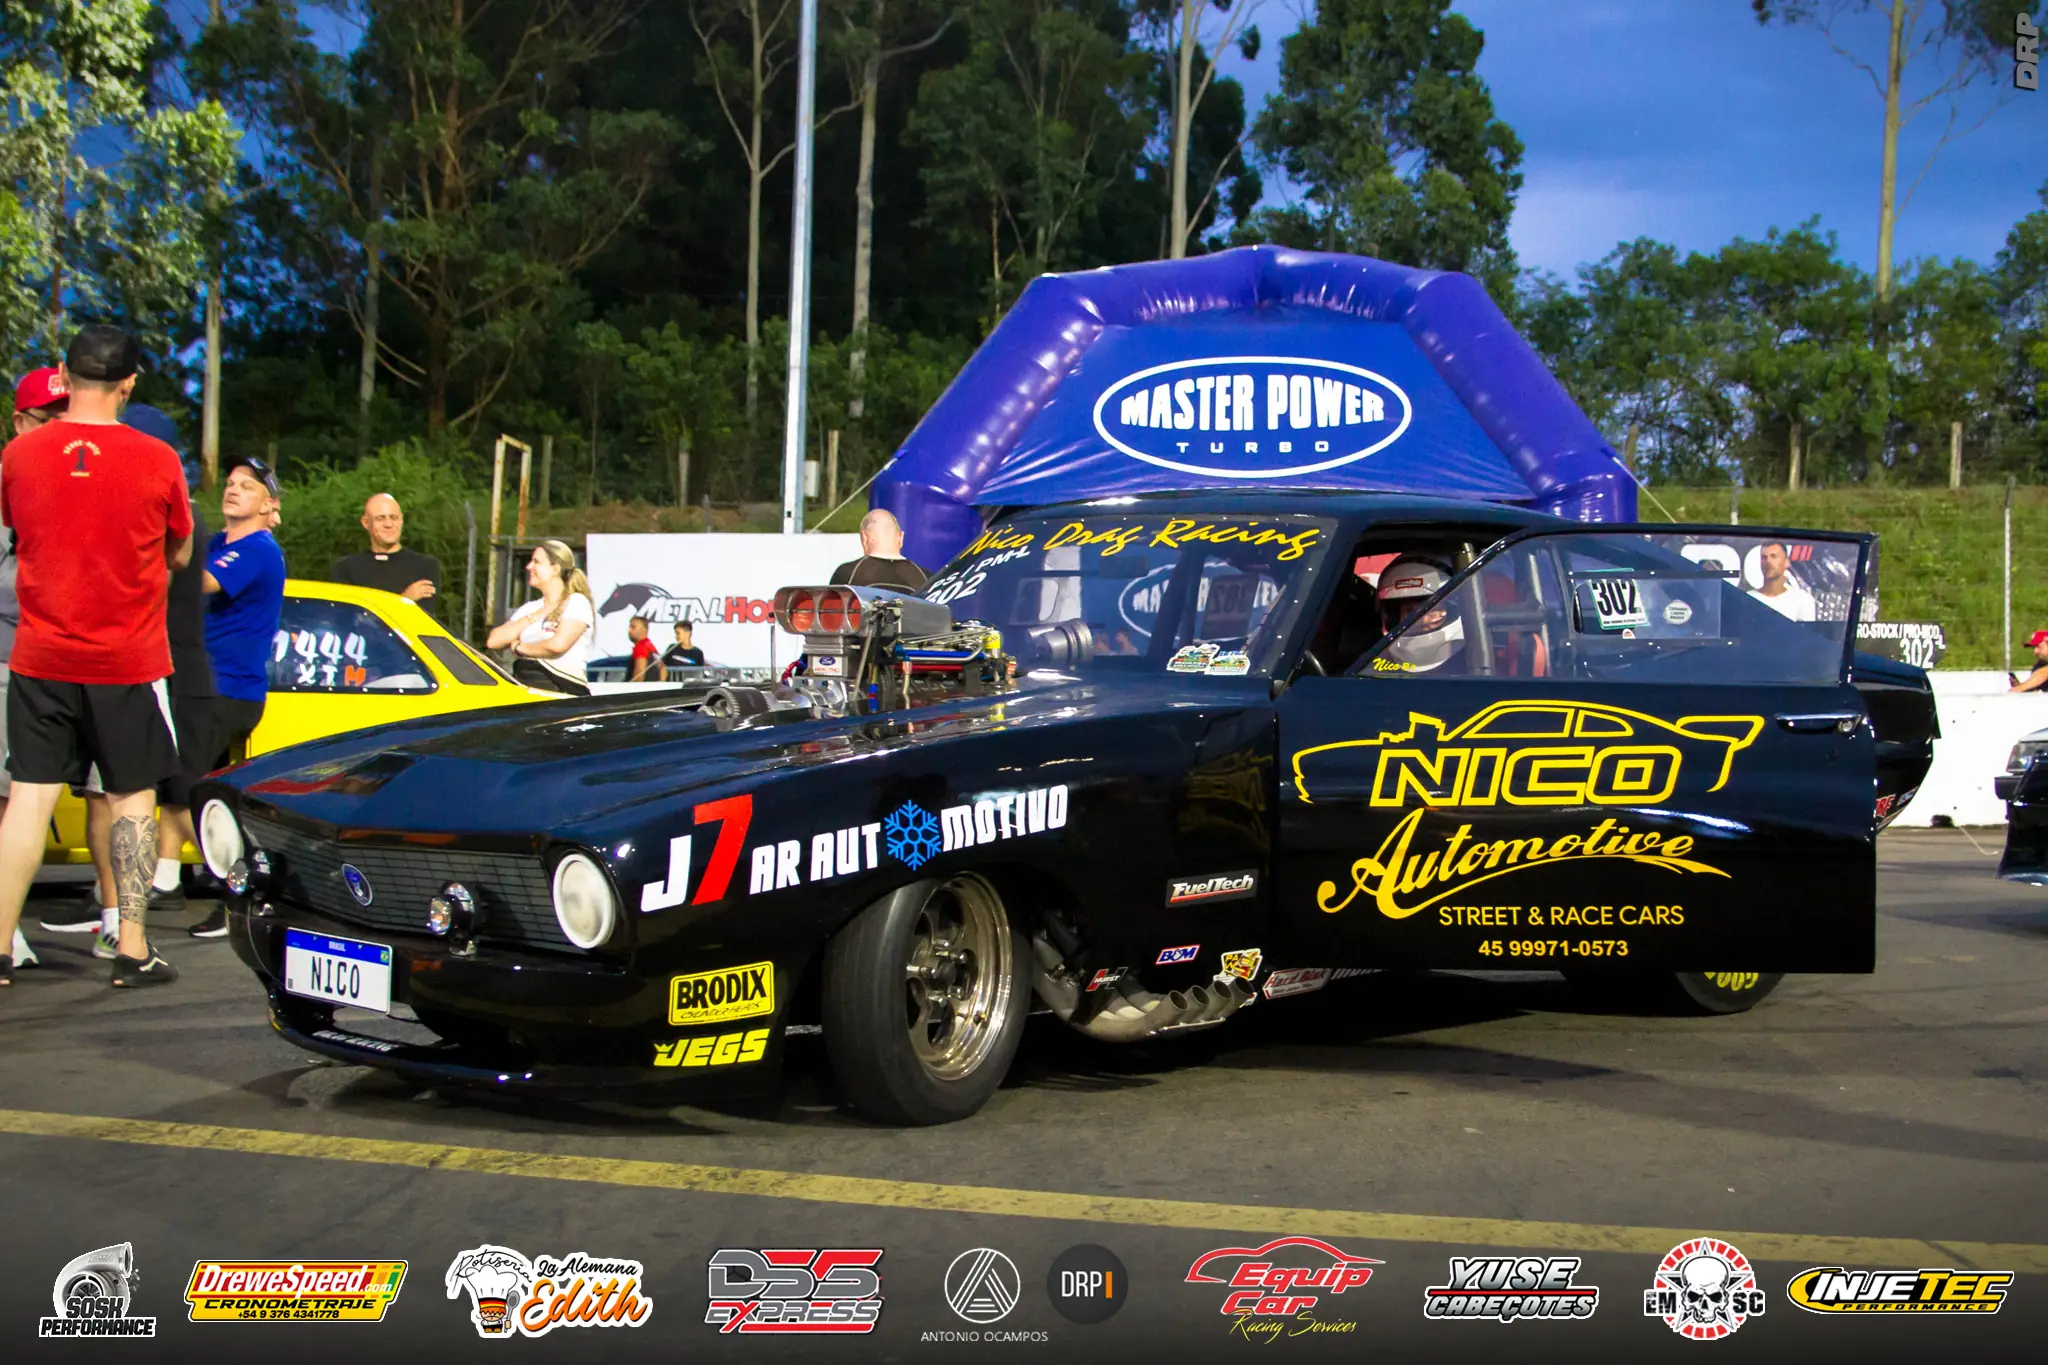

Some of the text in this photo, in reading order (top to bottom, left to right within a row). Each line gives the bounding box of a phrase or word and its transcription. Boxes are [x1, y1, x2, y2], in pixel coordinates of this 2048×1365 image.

[1121, 374, 1384, 431] MASTER POWER
[1176, 440, 1330, 454] TURBO
[959, 519, 1320, 561] Nico Drag Racing
[1592, 582, 1639, 616] 302
[1372, 657, 1401, 671] Nico
[1899, 638, 1934, 669] 302
[1369, 745, 1682, 807] NICO
[1317, 808, 1731, 919] Automotive
[1172, 874, 1254, 897] FuelTech
[1439, 905, 1684, 926] STREET & RACE CARS
[1157, 947, 1197, 963] B&M
[1479, 940, 1629, 957] 45 99971-0573
[311, 956, 360, 998] NICO
[676, 968, 767, 1010] BRODIX
[653, 1028, 770, 1067] JEGS
